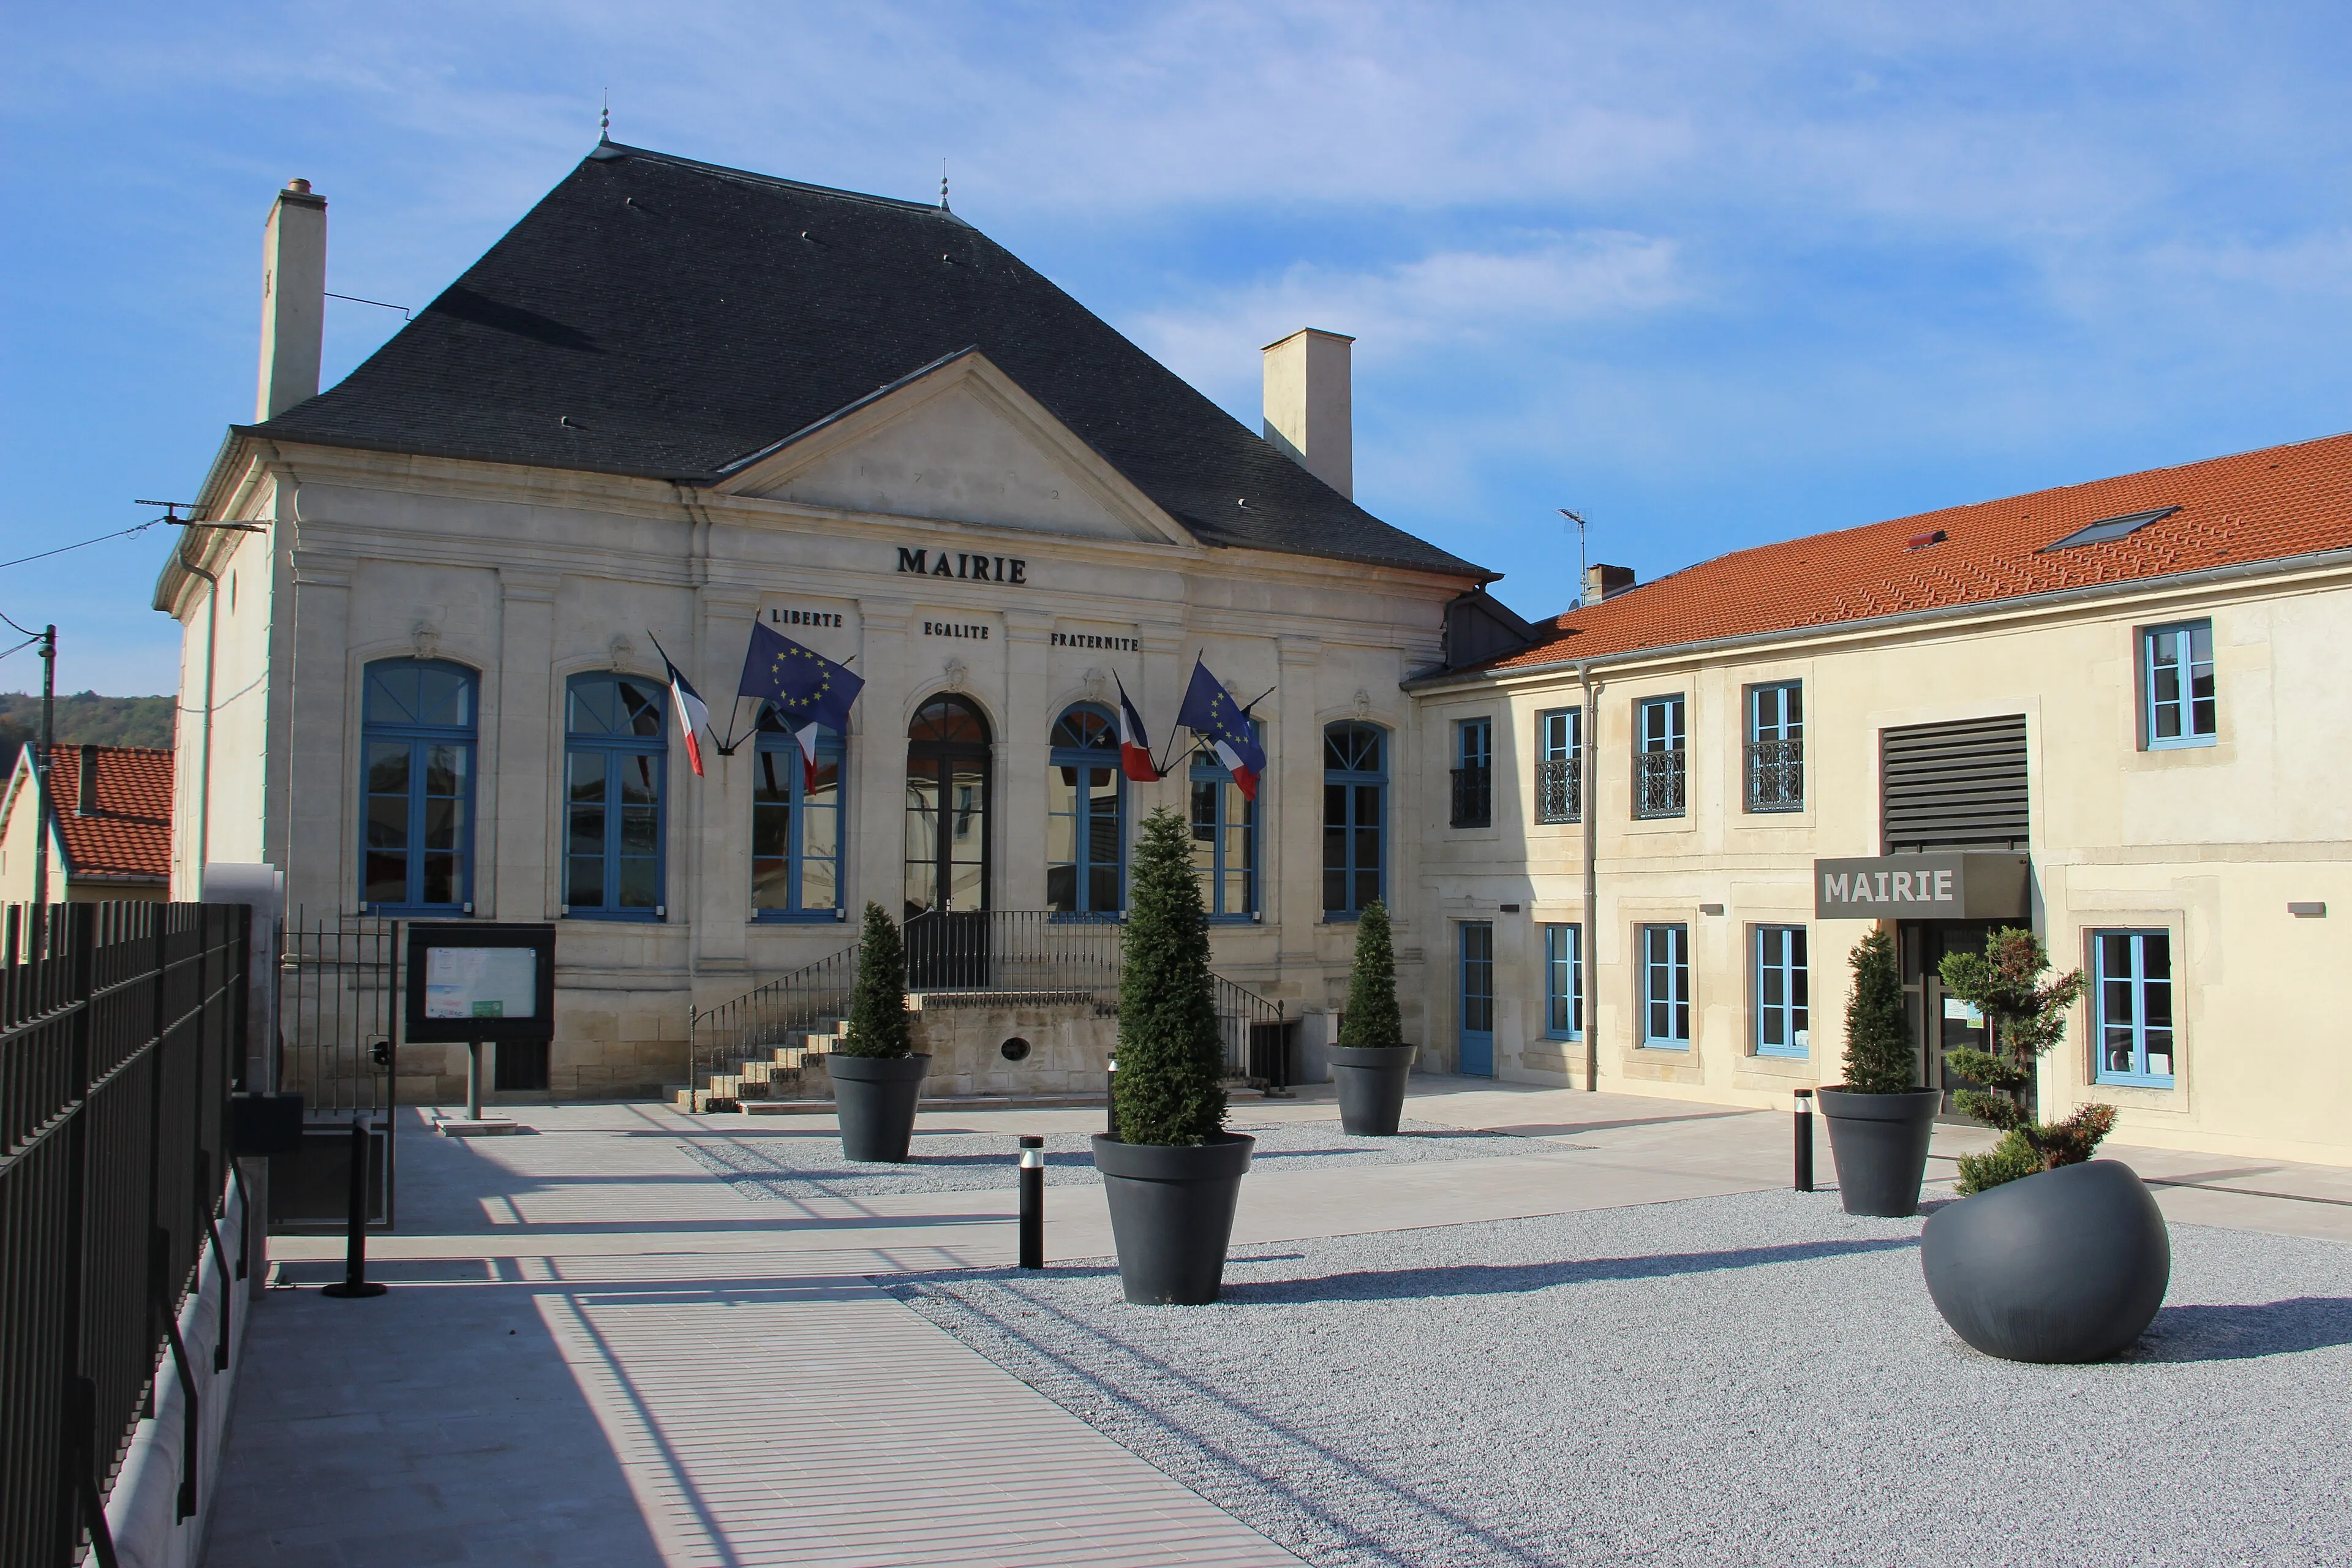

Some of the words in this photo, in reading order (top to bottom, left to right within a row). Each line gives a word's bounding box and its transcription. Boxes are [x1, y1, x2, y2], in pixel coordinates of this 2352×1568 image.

[897, 546, 1027, 584] MAIRIE
[772, 609, 842, 628] LIBERTE
[924, 621, 989, 640] EGALITE
[1050, 633, 1139, 652] FRATERNITE
[1824, 870, 1953, 903] MAIRIE
